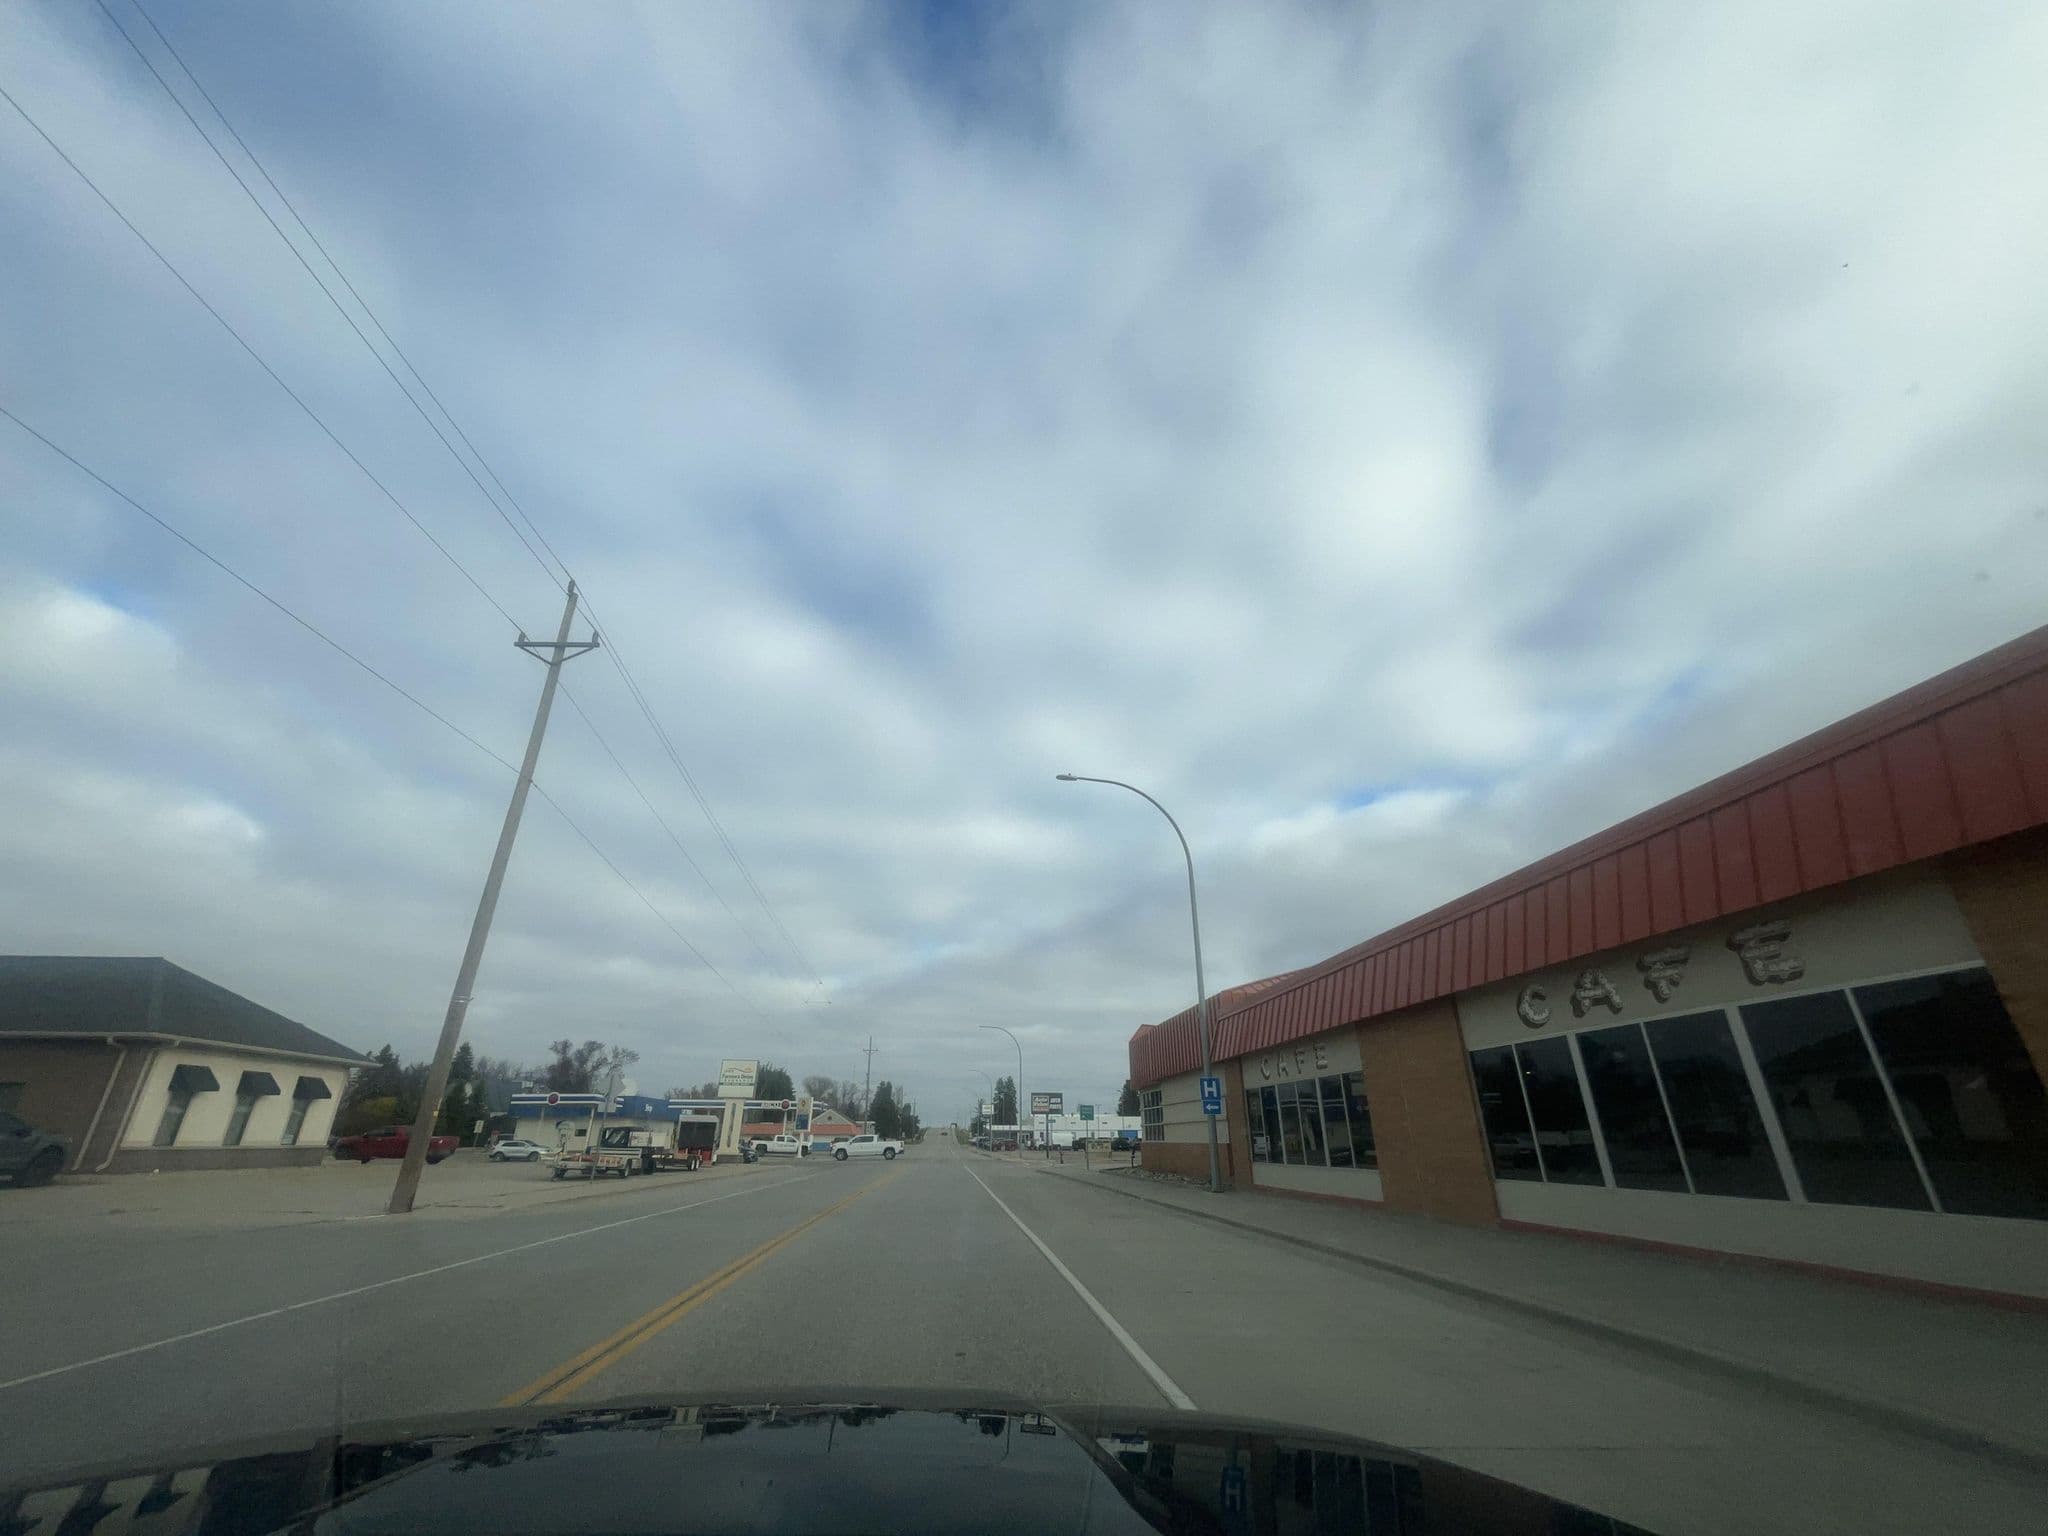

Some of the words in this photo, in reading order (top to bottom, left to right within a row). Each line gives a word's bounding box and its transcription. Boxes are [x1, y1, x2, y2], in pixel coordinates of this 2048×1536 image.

[1517, 919, 1807, 1028] CAFE
[1260, 1041, 1329, 1081] CAFE
[1203, 1080, 1218, 1098] H
